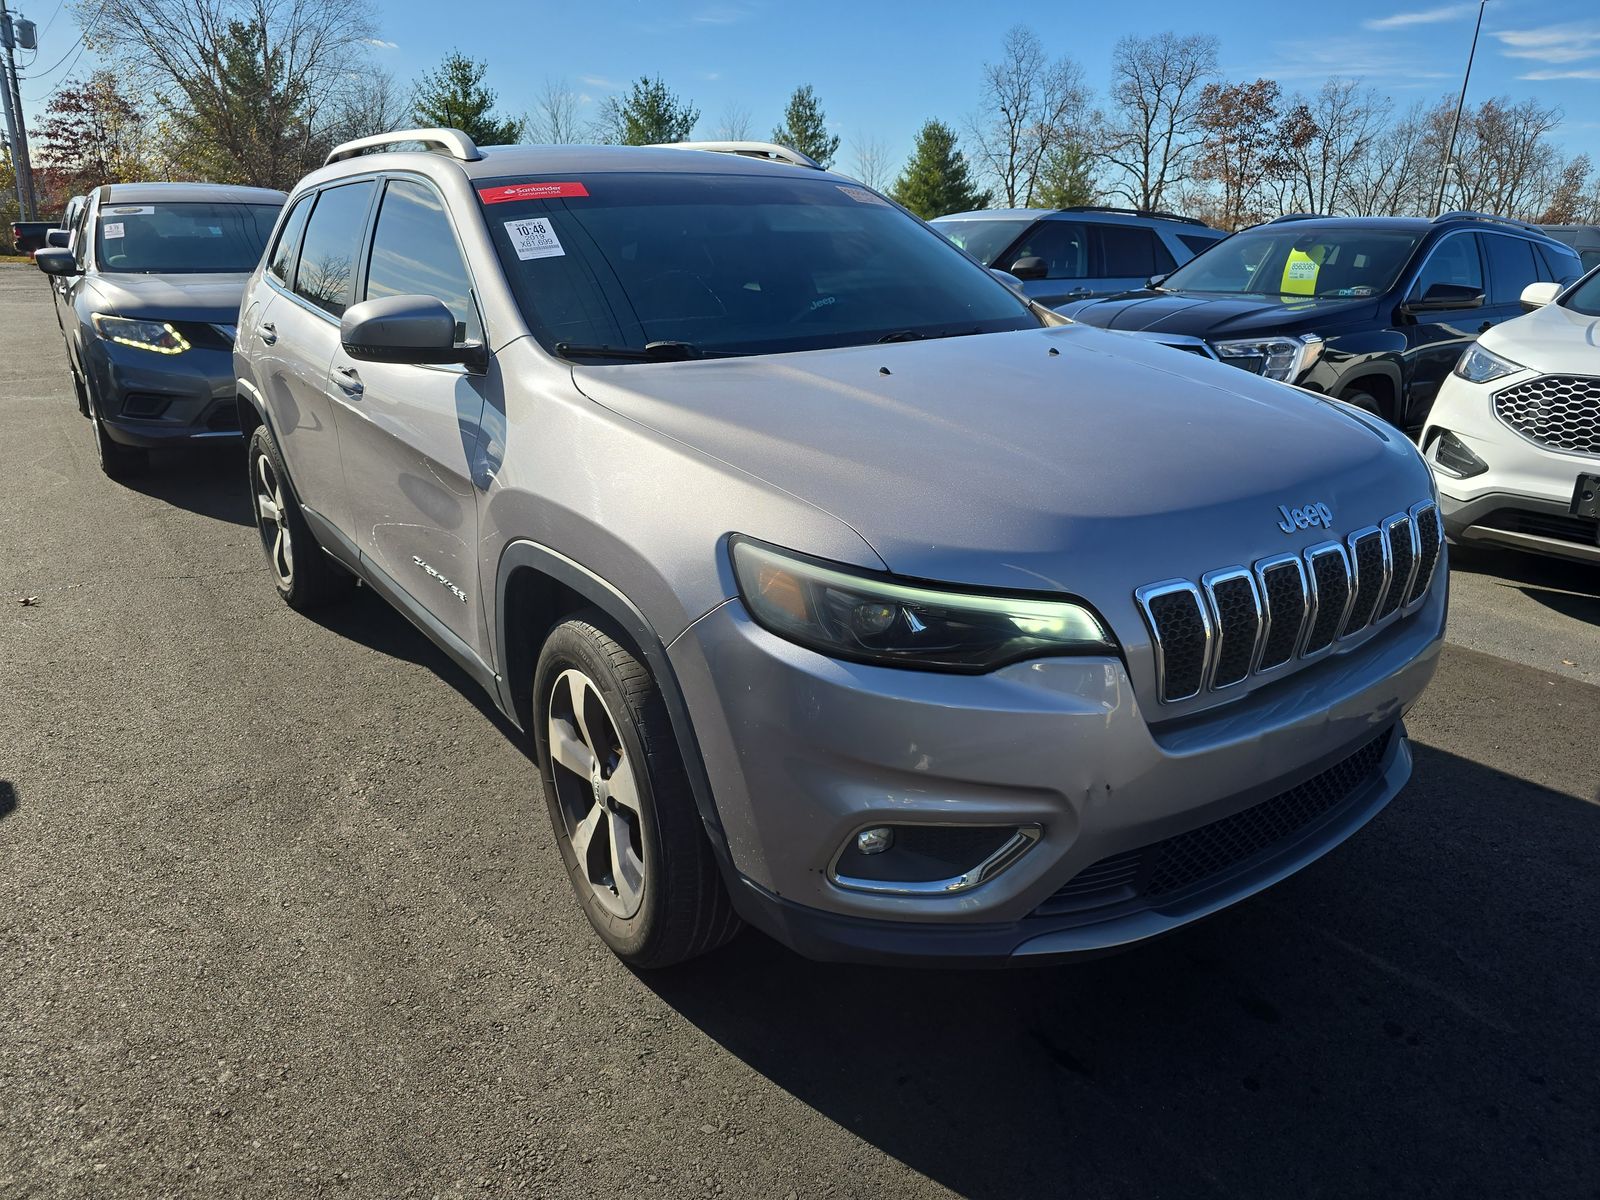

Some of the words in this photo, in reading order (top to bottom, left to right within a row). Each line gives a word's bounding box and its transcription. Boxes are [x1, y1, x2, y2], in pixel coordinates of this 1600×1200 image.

[516, 185, 561, 194] Santander
[516, 224, 546, 236] 10:48
[810, 296, 836, 310] Jeep
[1277, 502, 1333, 534] Jeep
